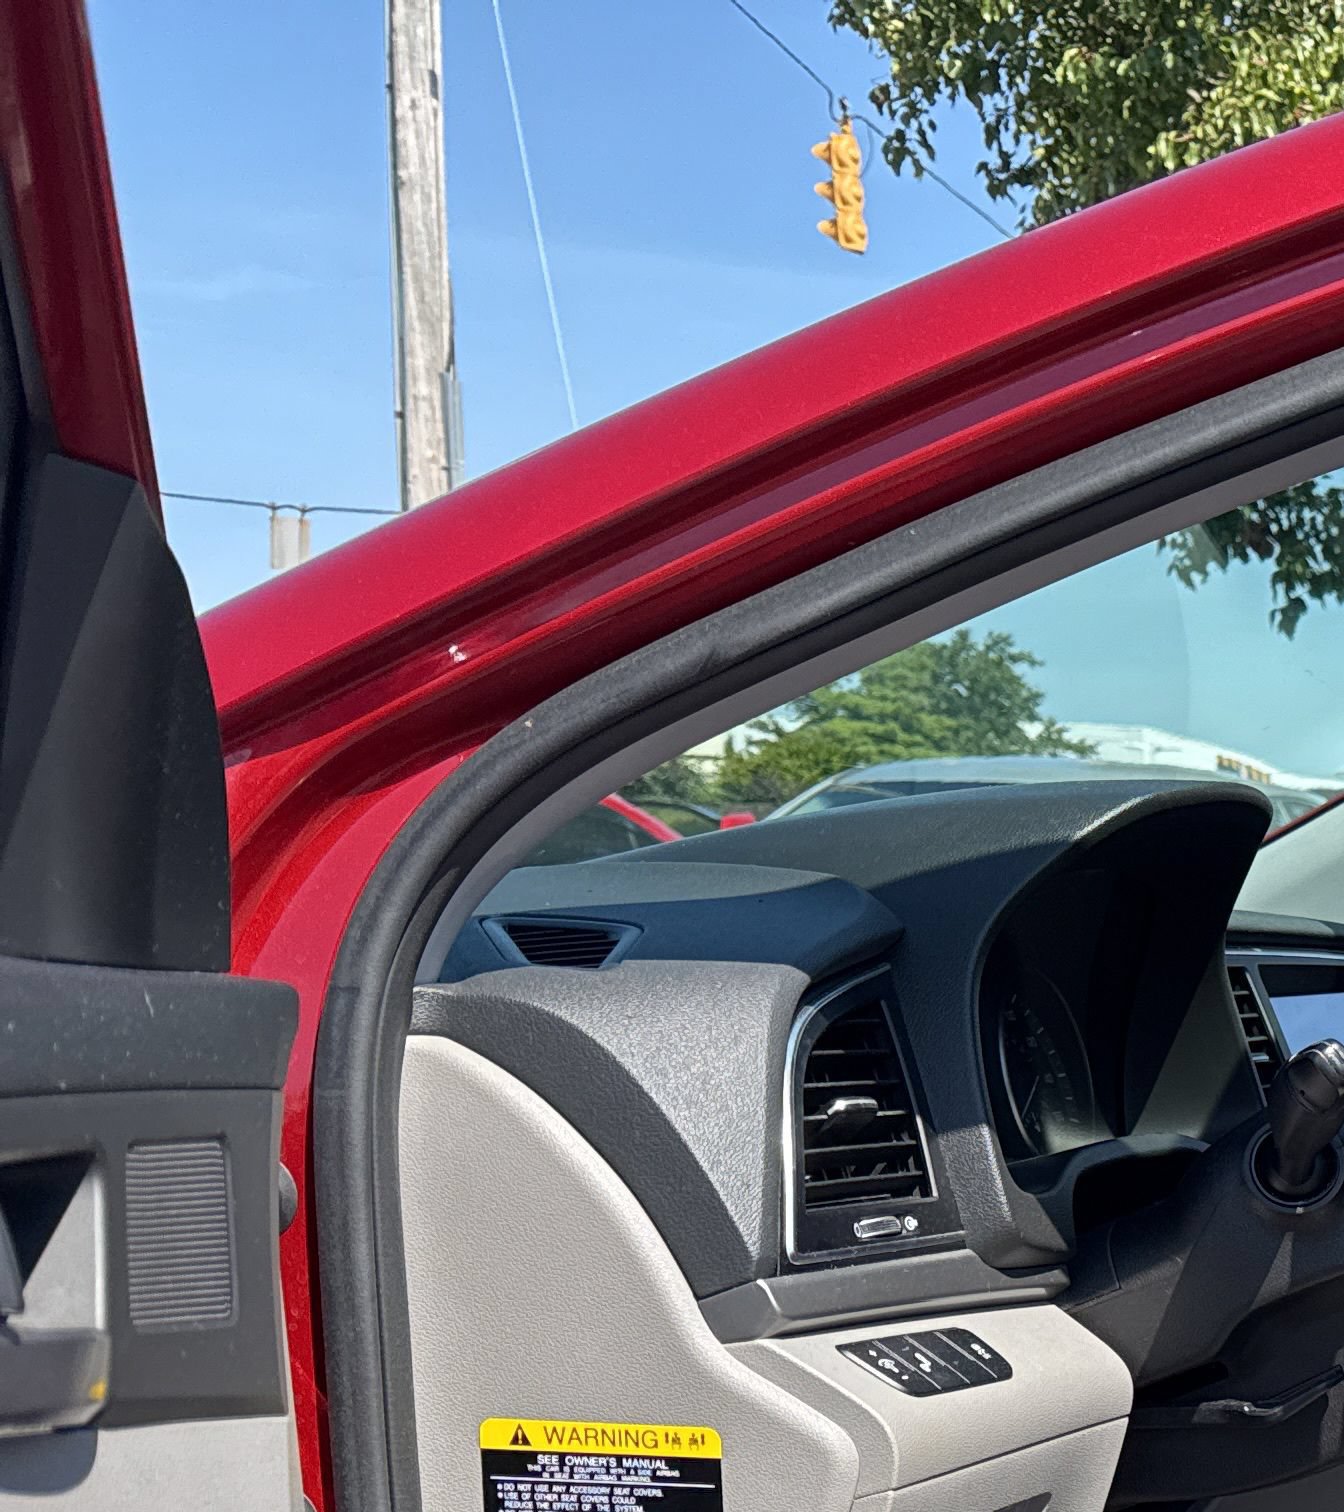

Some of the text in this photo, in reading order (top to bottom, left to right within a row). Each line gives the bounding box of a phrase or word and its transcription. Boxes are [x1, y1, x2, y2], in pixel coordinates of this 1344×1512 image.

[543, 1425, 658, 1448] WARNING
[537, 1454, 668, 1469] SEE OWNER'S MANUAL
[534, 1484, 548, 1492] USE
[569, 1486, 610, 1494] ACCESSORY
[613, 1487, 629, 1495] SEAT
[534, 1493, 557, 1501] OTHER
[611, 1496, 635, 1504] COULD
[504, 1500, 533, 1508] REDUCE
[536, 1501, 549, 1509] THE
[552, 1502, 578, 1510] EFFECT
[581, 1503, 591, 1511] OF
